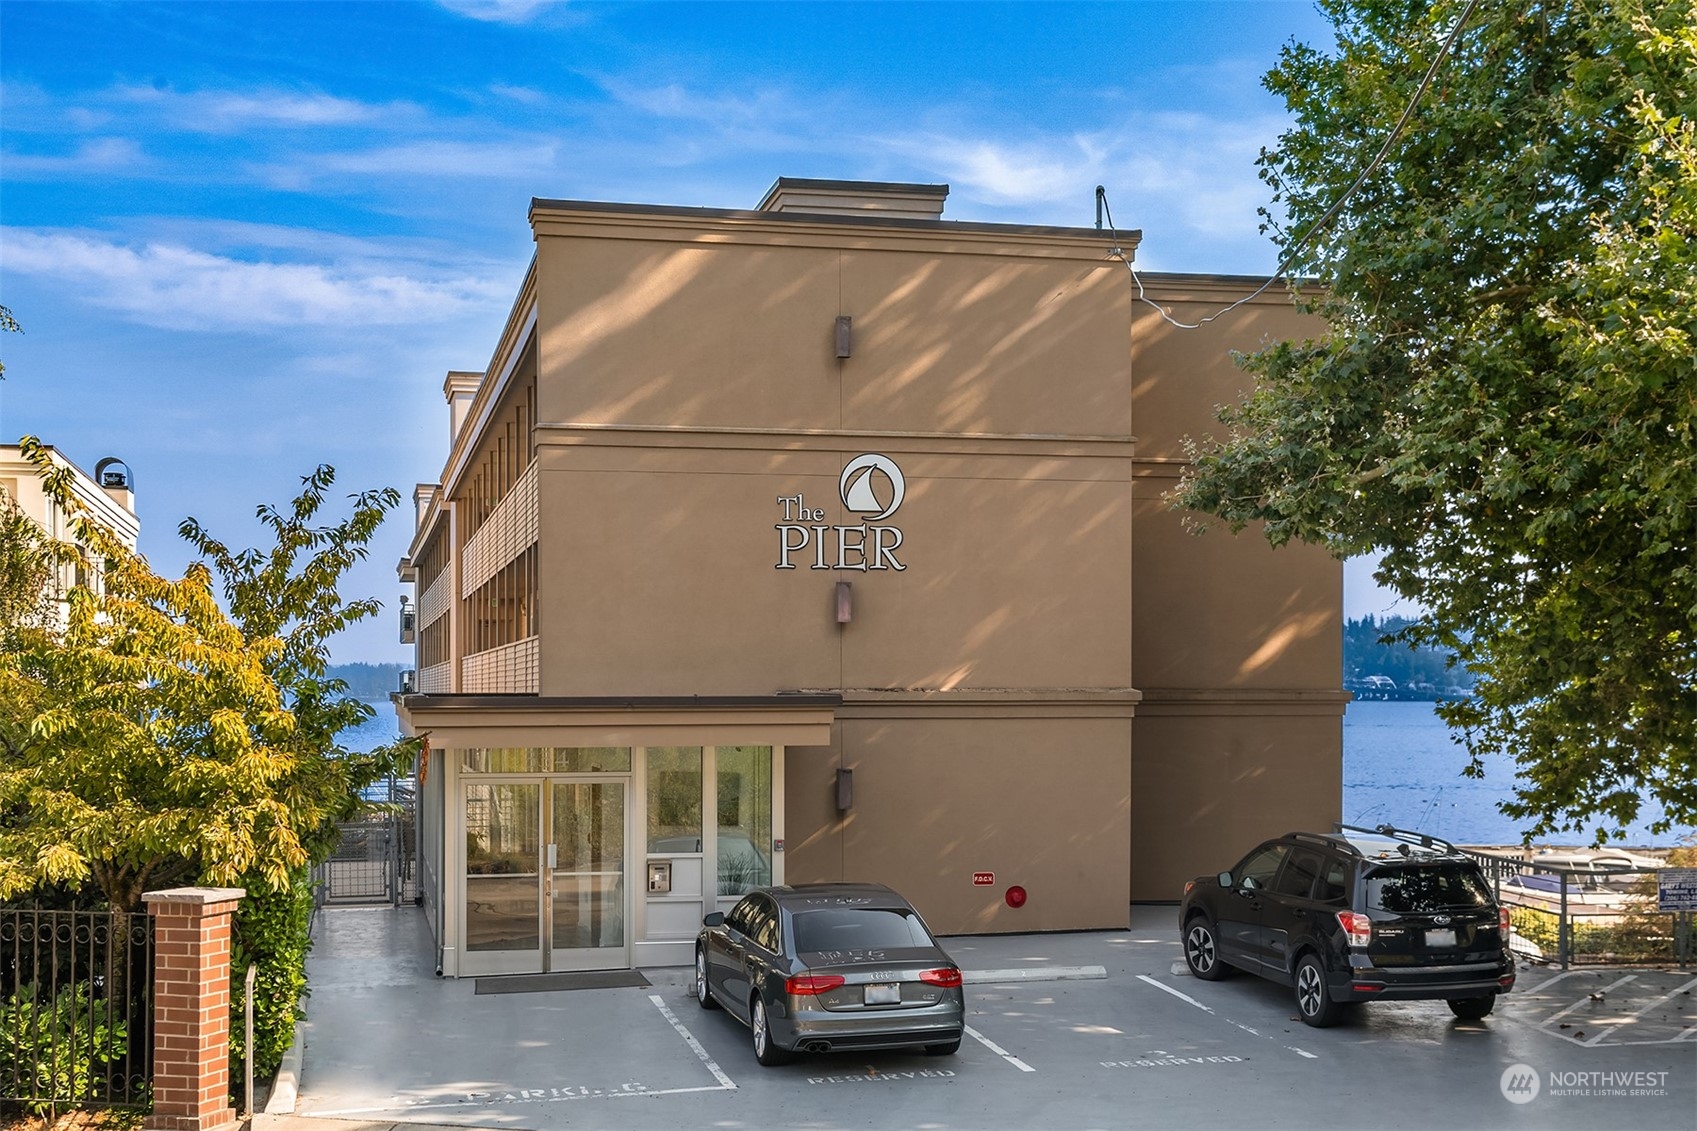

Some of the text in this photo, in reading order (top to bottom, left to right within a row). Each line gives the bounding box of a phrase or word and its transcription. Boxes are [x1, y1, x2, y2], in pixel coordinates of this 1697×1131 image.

[777, 493, 824, 521] The
[775, 523, 907, 572] PIER
[1100, 1055, 1243, 1069] RESERVED
[807, 1068, 956, 1085] RESERVED
